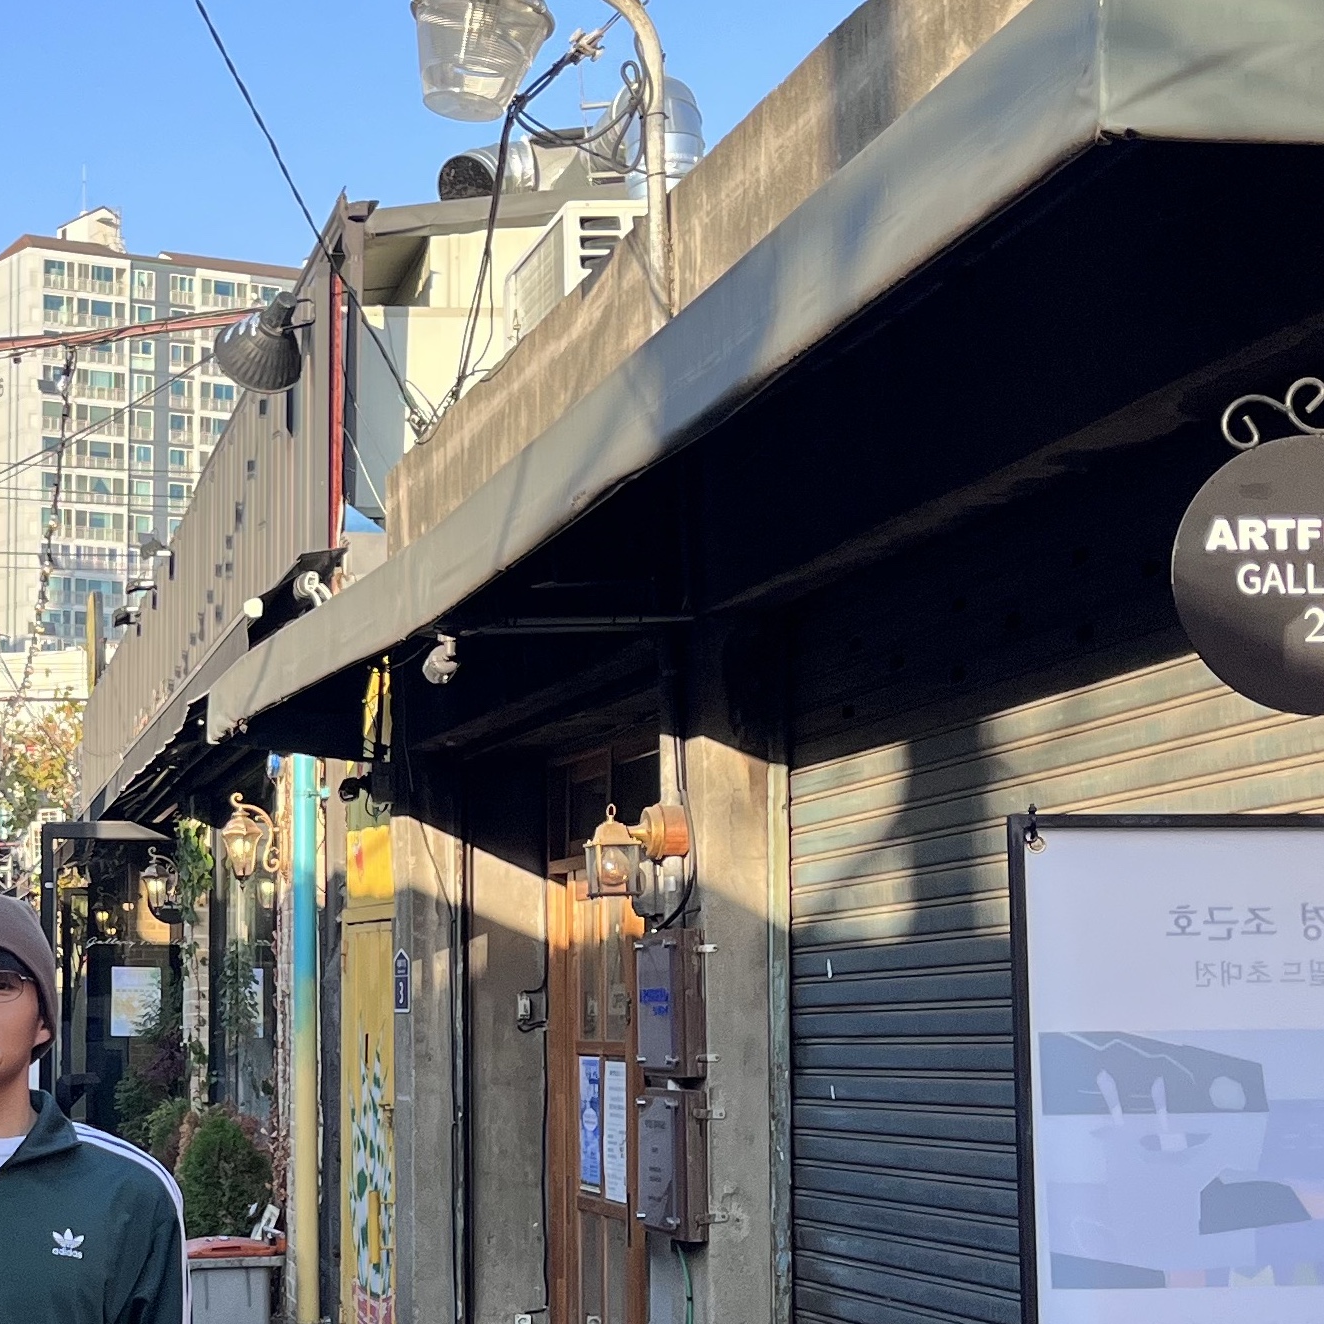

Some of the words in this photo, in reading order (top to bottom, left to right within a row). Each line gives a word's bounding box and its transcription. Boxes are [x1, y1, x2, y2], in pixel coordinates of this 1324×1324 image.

[1205, 518, 1322, 551] ARTF
[1237, 564, 1324, 595] GALL
[1304, 607, 1324, 643] 2
[51, 1247, 83, 1260] adidas
